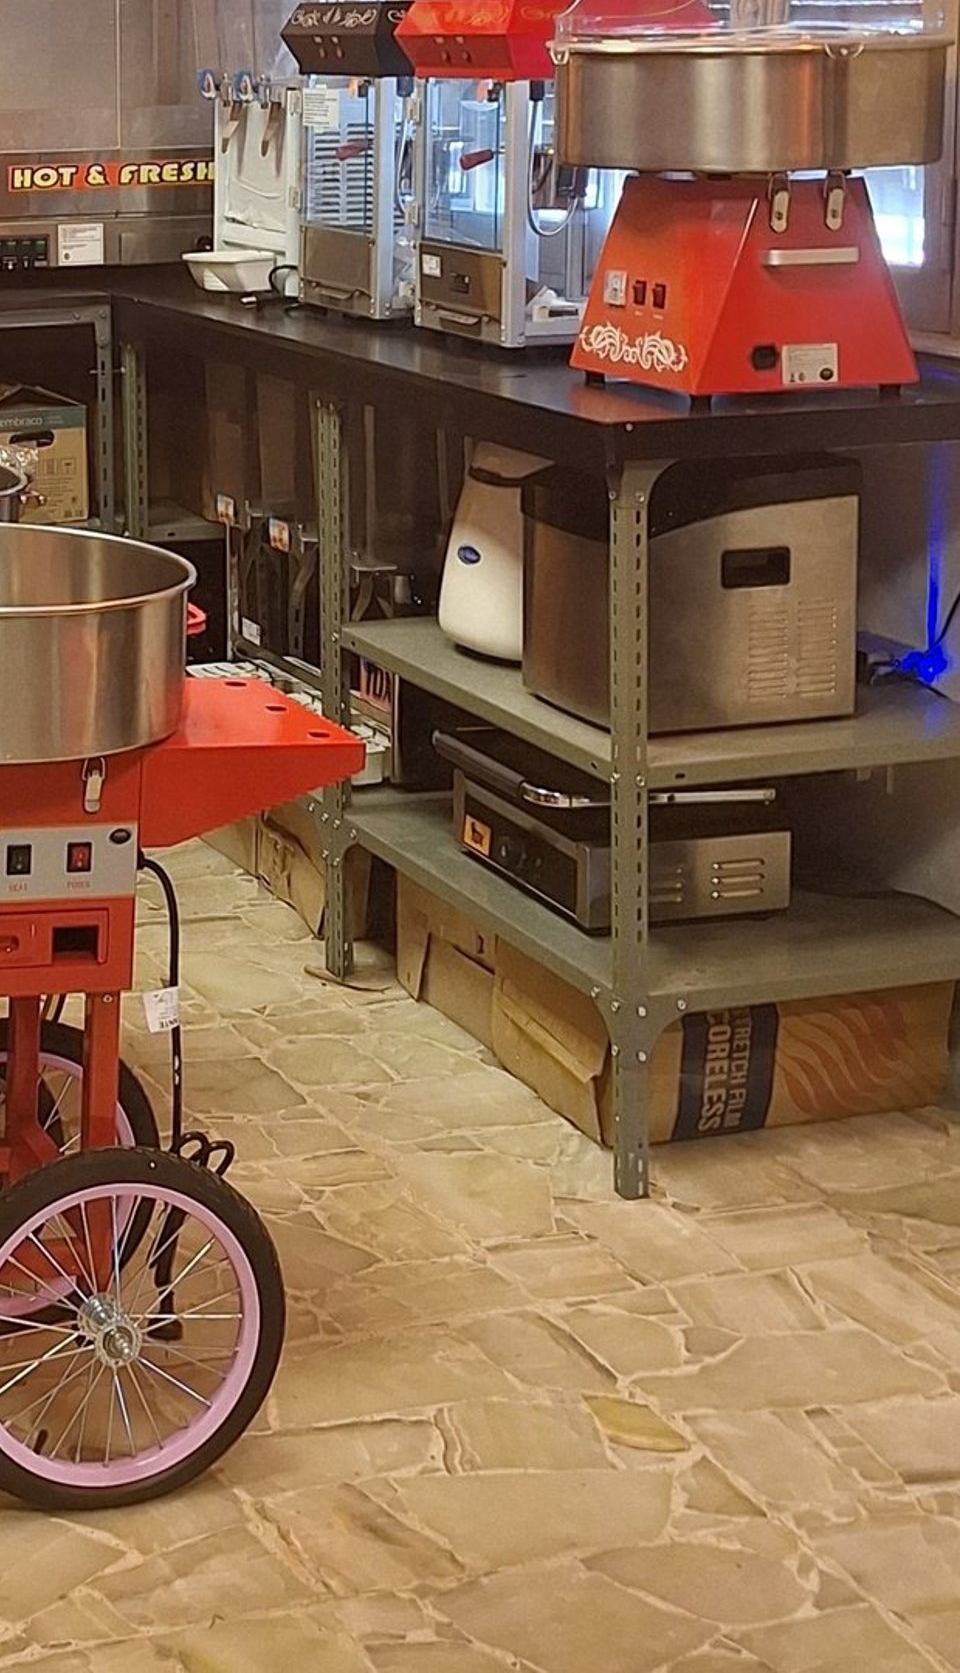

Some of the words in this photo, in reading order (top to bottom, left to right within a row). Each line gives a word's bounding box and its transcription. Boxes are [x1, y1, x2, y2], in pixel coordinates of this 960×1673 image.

[13, 165, 77, 189] HOT
[86, 163, 109, 186] &
[119, 159, 214, 185] FRESH
[698, 1011, 731, 1131] CORELESS
[723, 1088, 746, 1127] FILM
